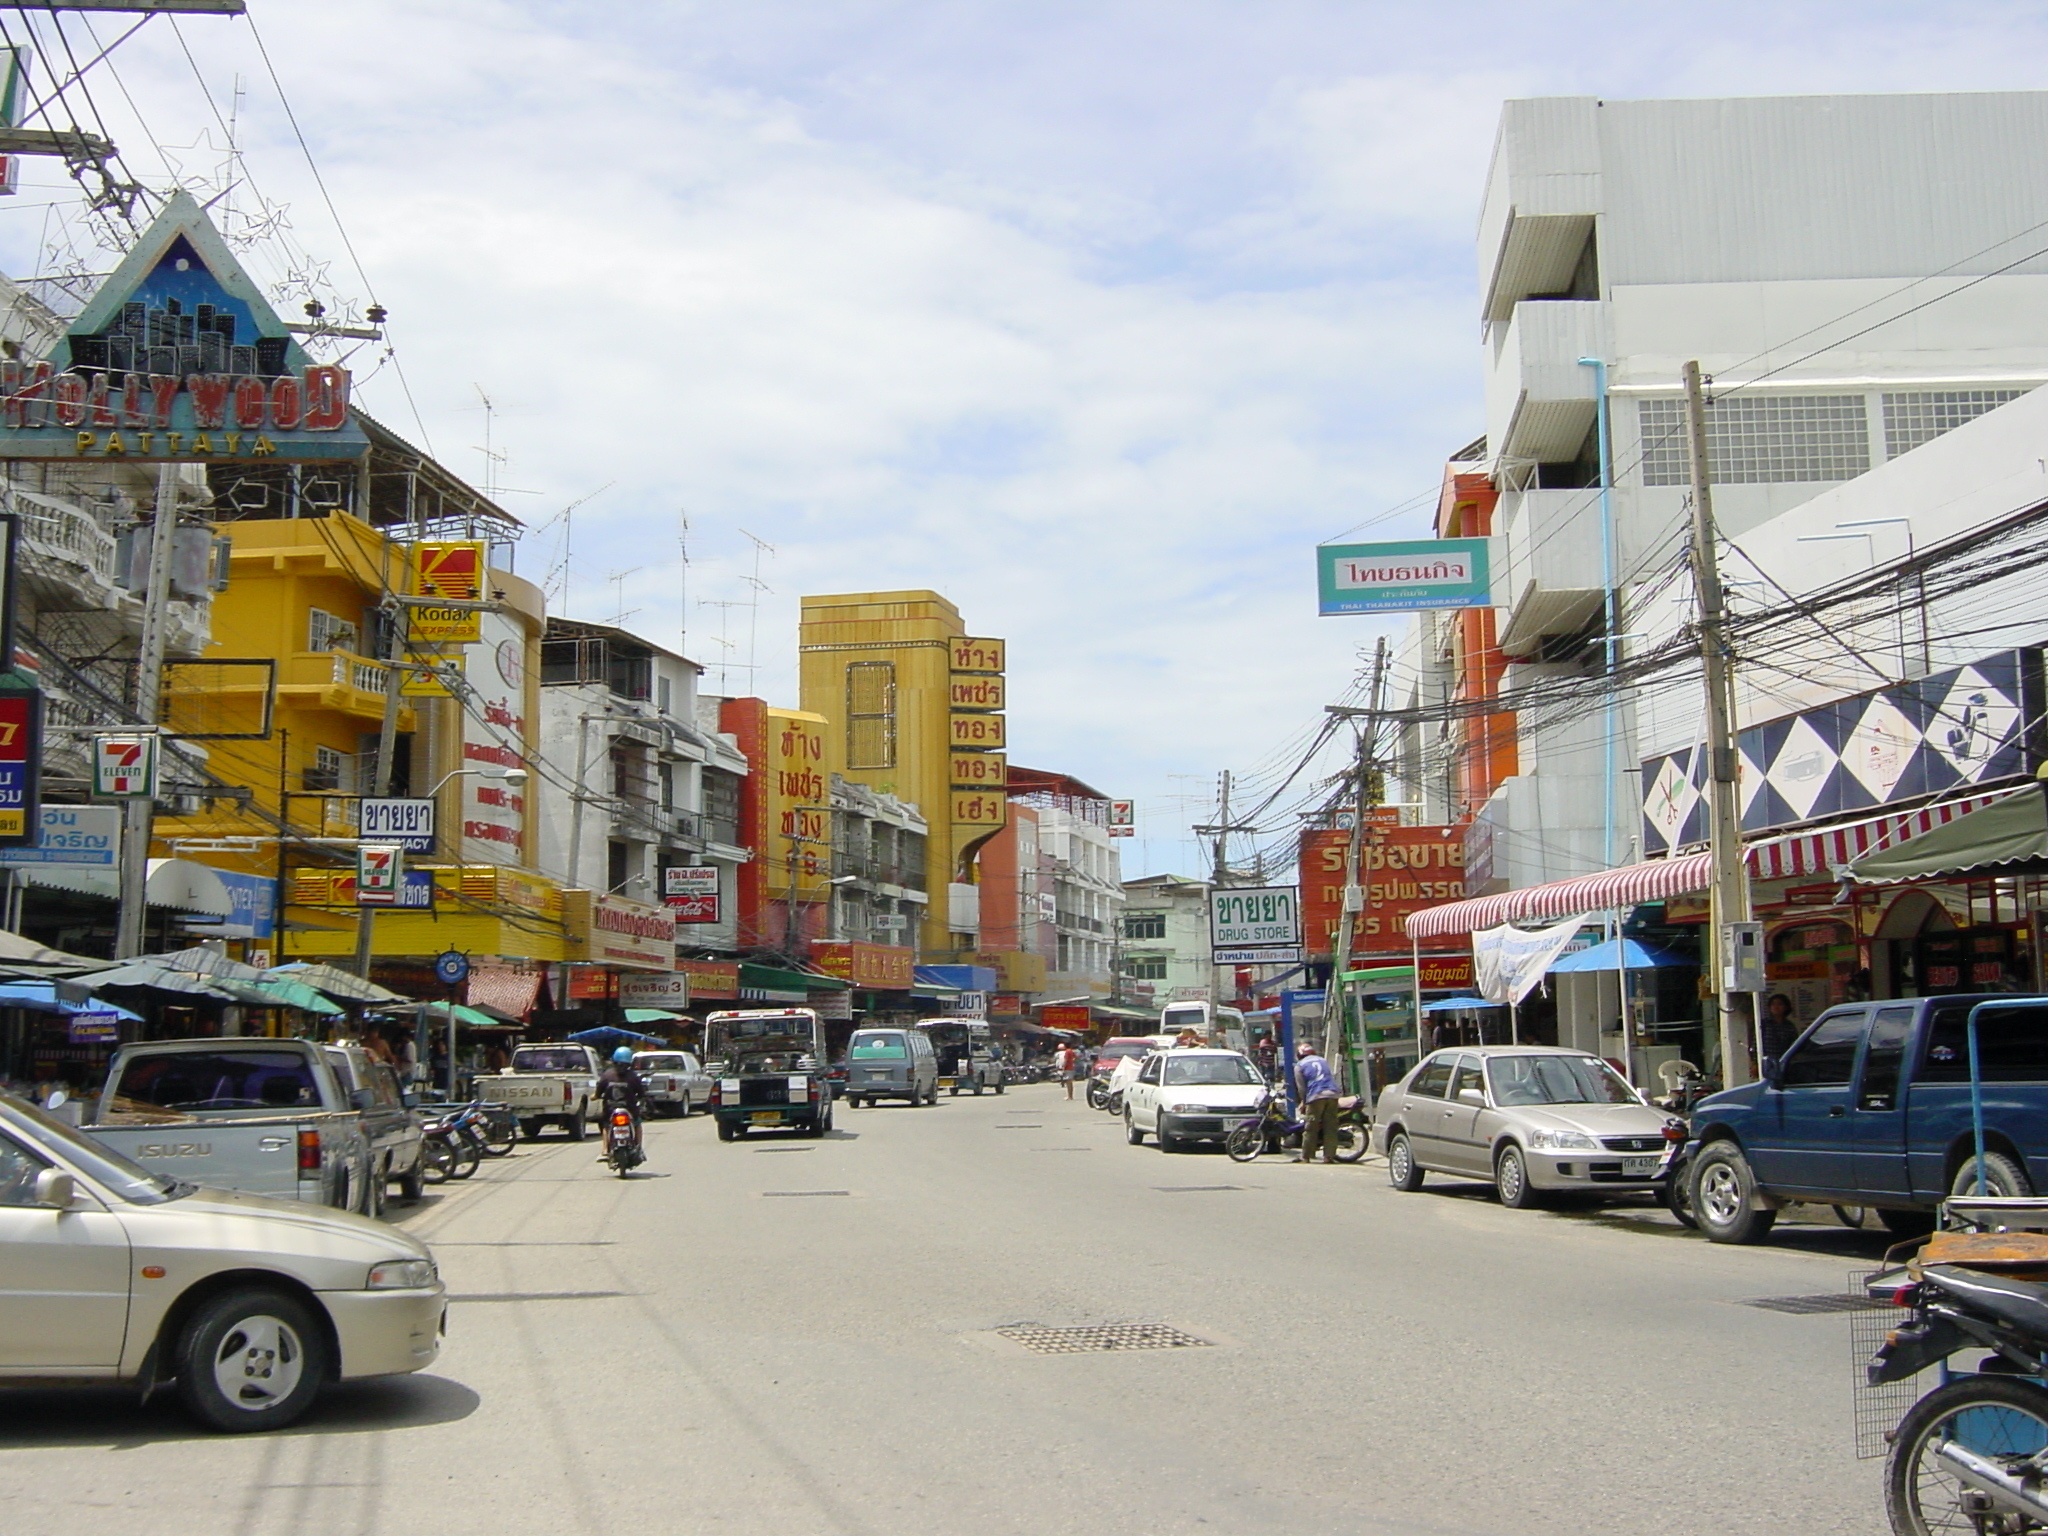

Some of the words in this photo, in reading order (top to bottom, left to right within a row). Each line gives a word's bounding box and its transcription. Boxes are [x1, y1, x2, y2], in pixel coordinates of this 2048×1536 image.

[1, 360, 348, 431] HOLLYWOOD
[77, 432, 277, 456] PATTAYA
[1344, 560, 1464, 584] ไทยธนกิจ
[1416, 598, 1470, 606] INSURANCE
[417, 606, 472, 622] Kodak
[955, 640, 999, 669] ห้าง
[952, 681, 1000, 705] เพชร
[954, 720, 1001, 740] ทอง
[781, 722, 821, 761] ห้าง
[103, 767, 141, 777] ELEVEN
[954, 758, 1001, 779] ทอง
[779, 766, 823, 800] เพชร
[365, 804, 430, 831] ขายยา
[1217, 894, 1290, 924] ขายยา
[1219, 928, 1249, 941] DRUG
[1254, 926, 1290, 939] STORE
[672, 981, 681, 993] 3
[1311, 1061, 1325, 1079] 2
[490, 1086, 553, 1098] NISSAN
[138, 1142, 213, 1160] ISUZU
